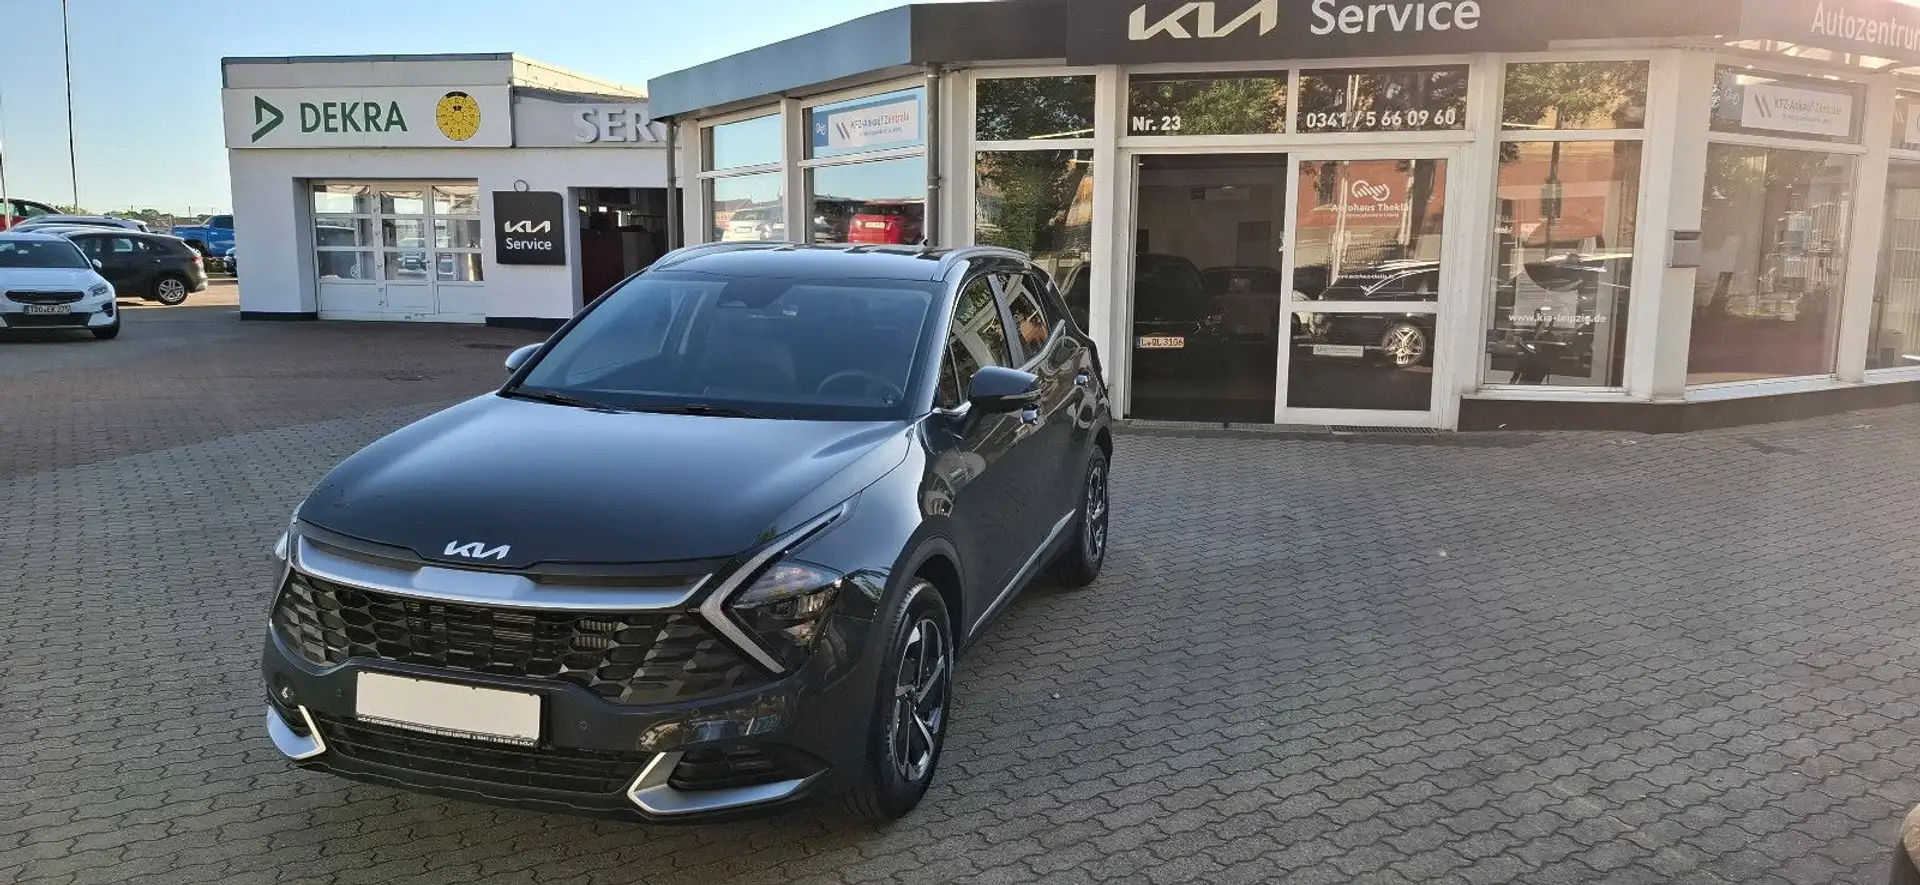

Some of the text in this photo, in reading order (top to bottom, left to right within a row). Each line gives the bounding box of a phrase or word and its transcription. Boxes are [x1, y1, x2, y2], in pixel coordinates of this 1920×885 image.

[1128, 0, 1481, 40] KIA Service
[300, 101, 407, 133] DEKRA
[574, 107, 666, 143] SER
[1133, 116, 1182, 131] Nr. 23
[1306, 112, 1347, 128] 0341
[1366, 112, 1377, 127] 5
[1381, 111, 1403, 127] 66
[1407, 110, 1430, 127] 09
[1434, 109, 1456, 126] 60
[504, 220, 551, 234] KIA
[506, 237, 552, 250] Service
[1508, 313, 1607, 325] www.kia-leipzig.de
[444, 540, 511, 559] KIA
